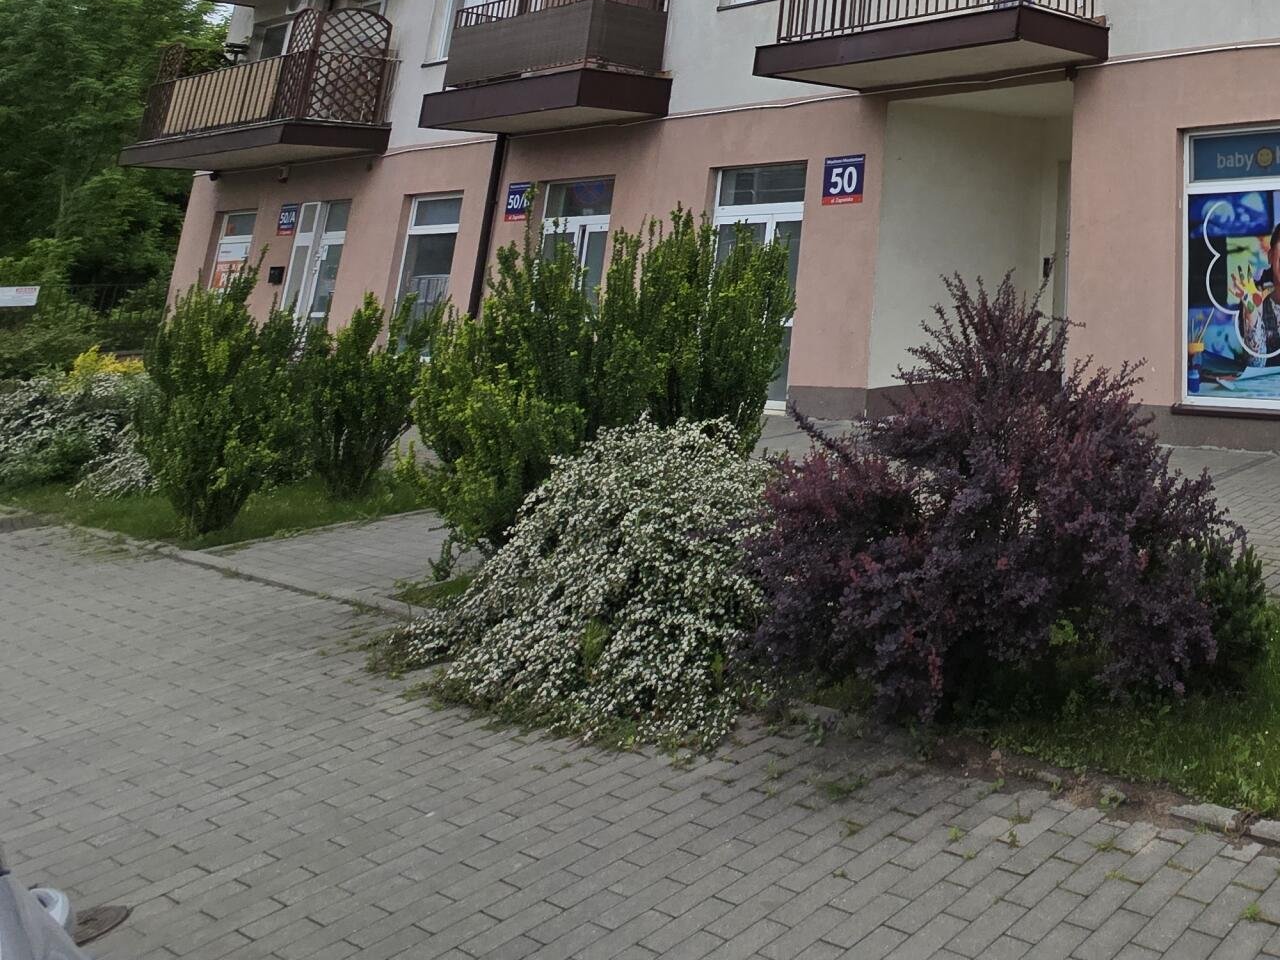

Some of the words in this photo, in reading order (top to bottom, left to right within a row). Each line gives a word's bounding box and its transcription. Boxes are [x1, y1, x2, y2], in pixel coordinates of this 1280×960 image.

[1216, 152, 1254, 171] baby
[829, 166, 857, 194] 50
[279, 211, 296, 224] 50/A
